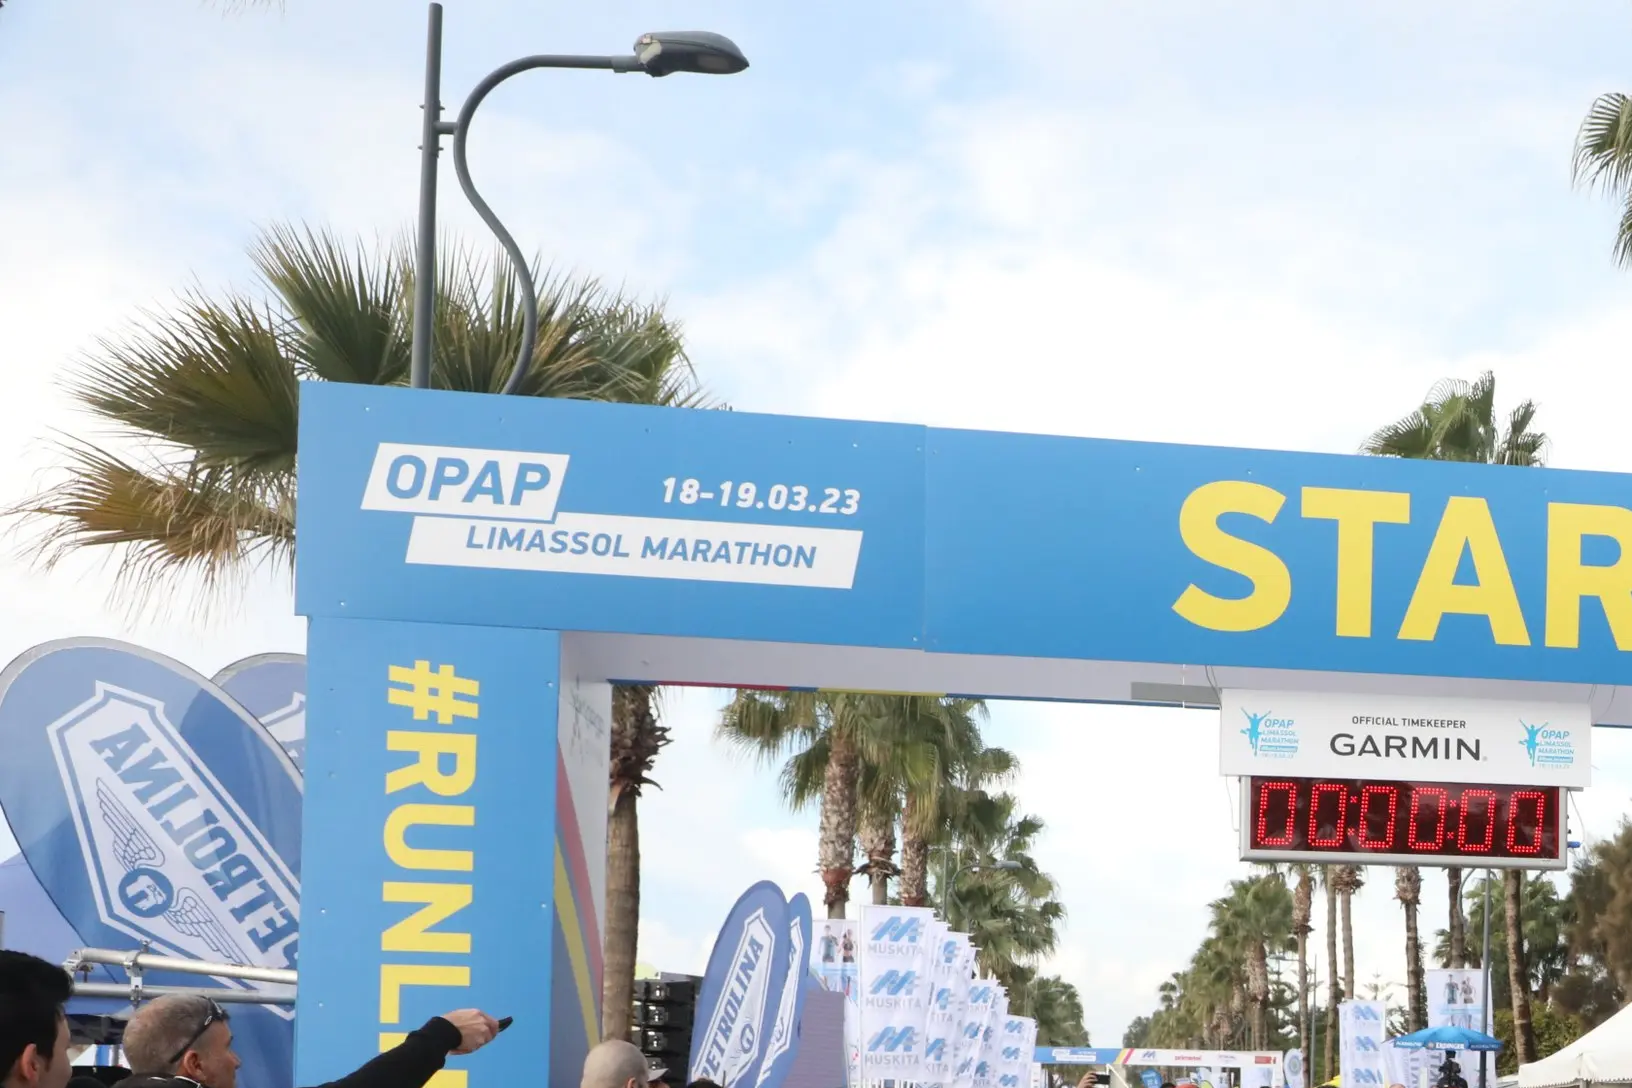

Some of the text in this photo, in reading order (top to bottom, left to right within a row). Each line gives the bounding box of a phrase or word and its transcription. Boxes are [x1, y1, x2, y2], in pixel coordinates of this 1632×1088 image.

[386, 454, 552, 507] OPAP
[662, 476, 861, 516] 18-19.03.23
[465, 524, 817, 570] LIMASSOL MARATHON
[1264, 718, 1295, 729] OPAP
[1351, 715, 1467, 729] OFFICIAL TIMEKEEPER
[1541, 729, 1571, 740] OPAP
[1330, 732, 1481, 761] GARMIN
[867, 943, 925, 956] MUSKITA
[865, 997, 923, 1010] MUSKITA
[864, 1053, 920, 1066] MUSKITA
